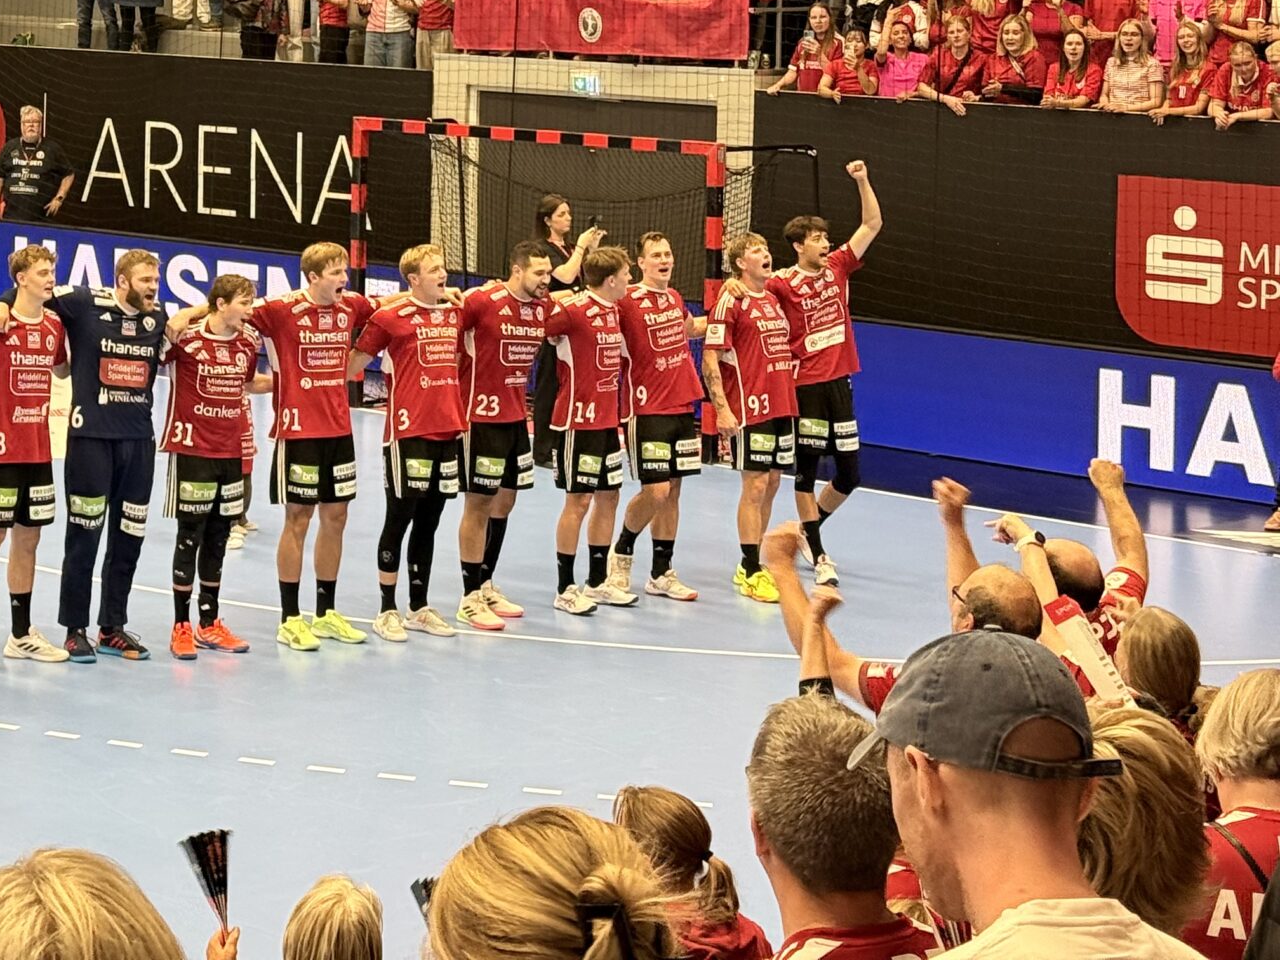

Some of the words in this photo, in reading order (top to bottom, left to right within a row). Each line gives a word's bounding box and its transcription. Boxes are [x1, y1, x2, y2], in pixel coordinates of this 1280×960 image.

[81, 118, 372, 231] ARENA
[101, 337, 154, 357] thansen
[299, 330, 349, 343] thansen
[10, 351, 54, 366] thansen
[476, 394, 500, 417] 23
[637, 385, 648, 406] 9
[748, 393, 770, 416] 93
[283, 408, 302, 431] 91
[574, 401, 596, 423] 14
[171, 421, 194, 447] 31
